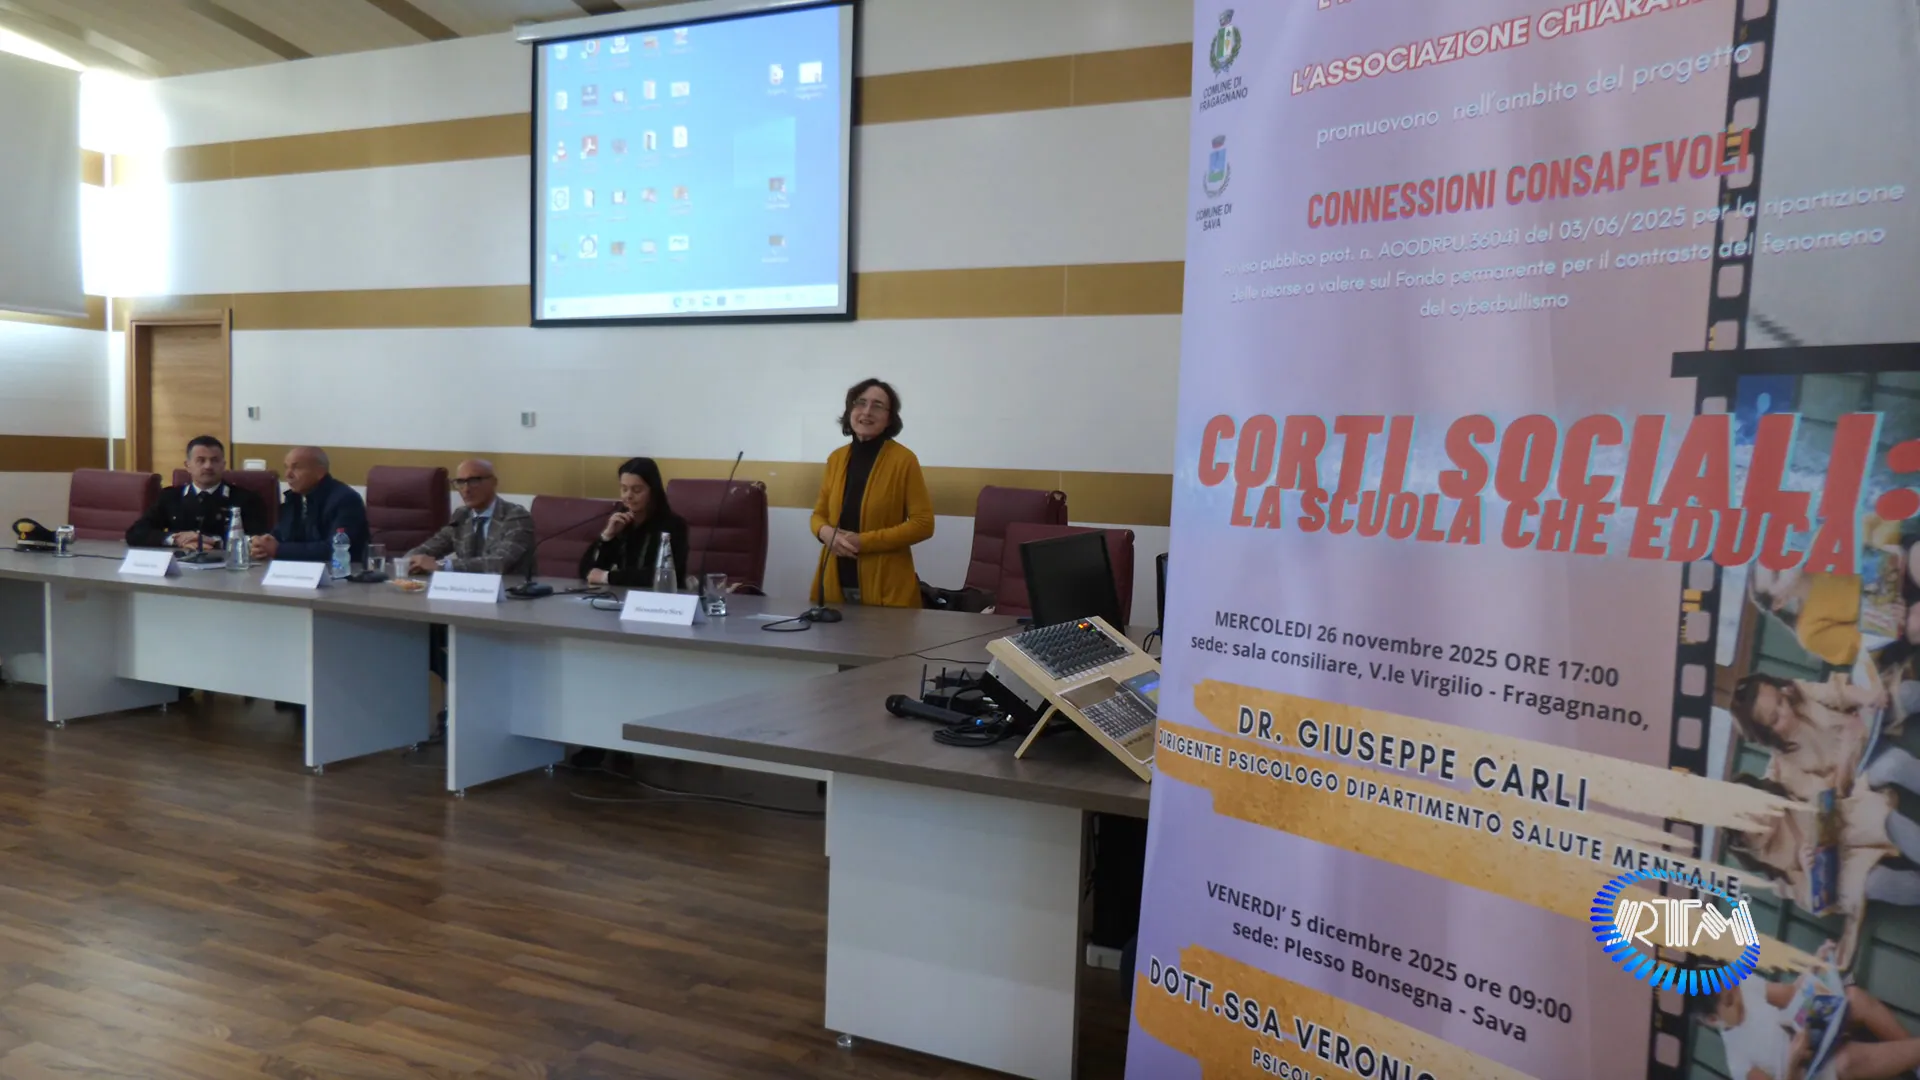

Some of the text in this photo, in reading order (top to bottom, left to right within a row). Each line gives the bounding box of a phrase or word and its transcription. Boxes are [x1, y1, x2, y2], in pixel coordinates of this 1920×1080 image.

[1203, 76, 1242, 99] COMUNE DI
[1290, 15, 1531, 96] L'ASSOCIAZIONE
[1316, 43, 1752, 147] promuovono nell'ambito del progetto
[1195, 203, 1232, 221] COMUNE DI
[1307, 127, 1752, 229] CONNESSIONI CONSAPEVOLI
[1203, 217, 1221, 231] SAVA
[1261, 250, 1316, 274] pubblico
[1320, 246, 1353, 268] prot.
[1525, 221, 1553, 245] del
[1559, 205, 1687, 242] 03/06/2025
[1692, 204, 1730, 232] per
[1736, 195, 1755, 219] la
[1764, 180, 1906, 219] ripartizione
[1262, 283, 1301, 299] risorse
[1305, 283, 1315, 295] a
[1319, 275, 1365, 294] valere
[1369, 269, 1391, 291] sul
[1396, 266, 1446, 288] Fondo
[1450, 259, 1556, 290] permanente
[1562, 256, 1593, 279] per
[1599, 249, 1609, 271] il
[1615, 242, 1712, 269] contrasto
[1719, 232, 1755, 258] del
[1762, 228, 1887, 255] fenomeno
[1420, 291, 1569, 321] del cyberbullismo
[1198, 413, 1418, 497] CORTI
[1230, 485, 1861, 574] LA SCUOLA CHE EDUCA
[1191, 635, 1228, 655] sede:
[1232, 642, 1266, 661] sala
[1271, 649, 1362, 680] consiliare,
[1369, 661, 1405, 684] V.le
[1411, 668, 1483, 698] Virgilio
[1503, 684, 1649, 731] Fragagnano,
[1215, 610, 1619, 688] MERCOLEDI 26 novembre 2025 ORE 17:00
[1239, 705, 1587, 812] DR. GIUSEPPE CARLI
[1228, 750, 1339, 792] PSICOLOGO
[1346, 778, 1502, 834] DIPARTIMENTO
[1512, 819, 1603, 861] SALUTE
[1207, 880, 1573, 1024] VENERDI' 5 dicembre 2025 ore 09:00
[1233, 921, 1279, 950] sede:
[1285, 937, 1346, 972] Plesso
[1352, 959, 1453, 1015] Bonsegna
[1472, 1005, 1528, 1043] Sava
[1150, 956, 1434, 1080] DOTT.SSA VERONIC
[1252, 1049, 1326, 1080] PSICO
